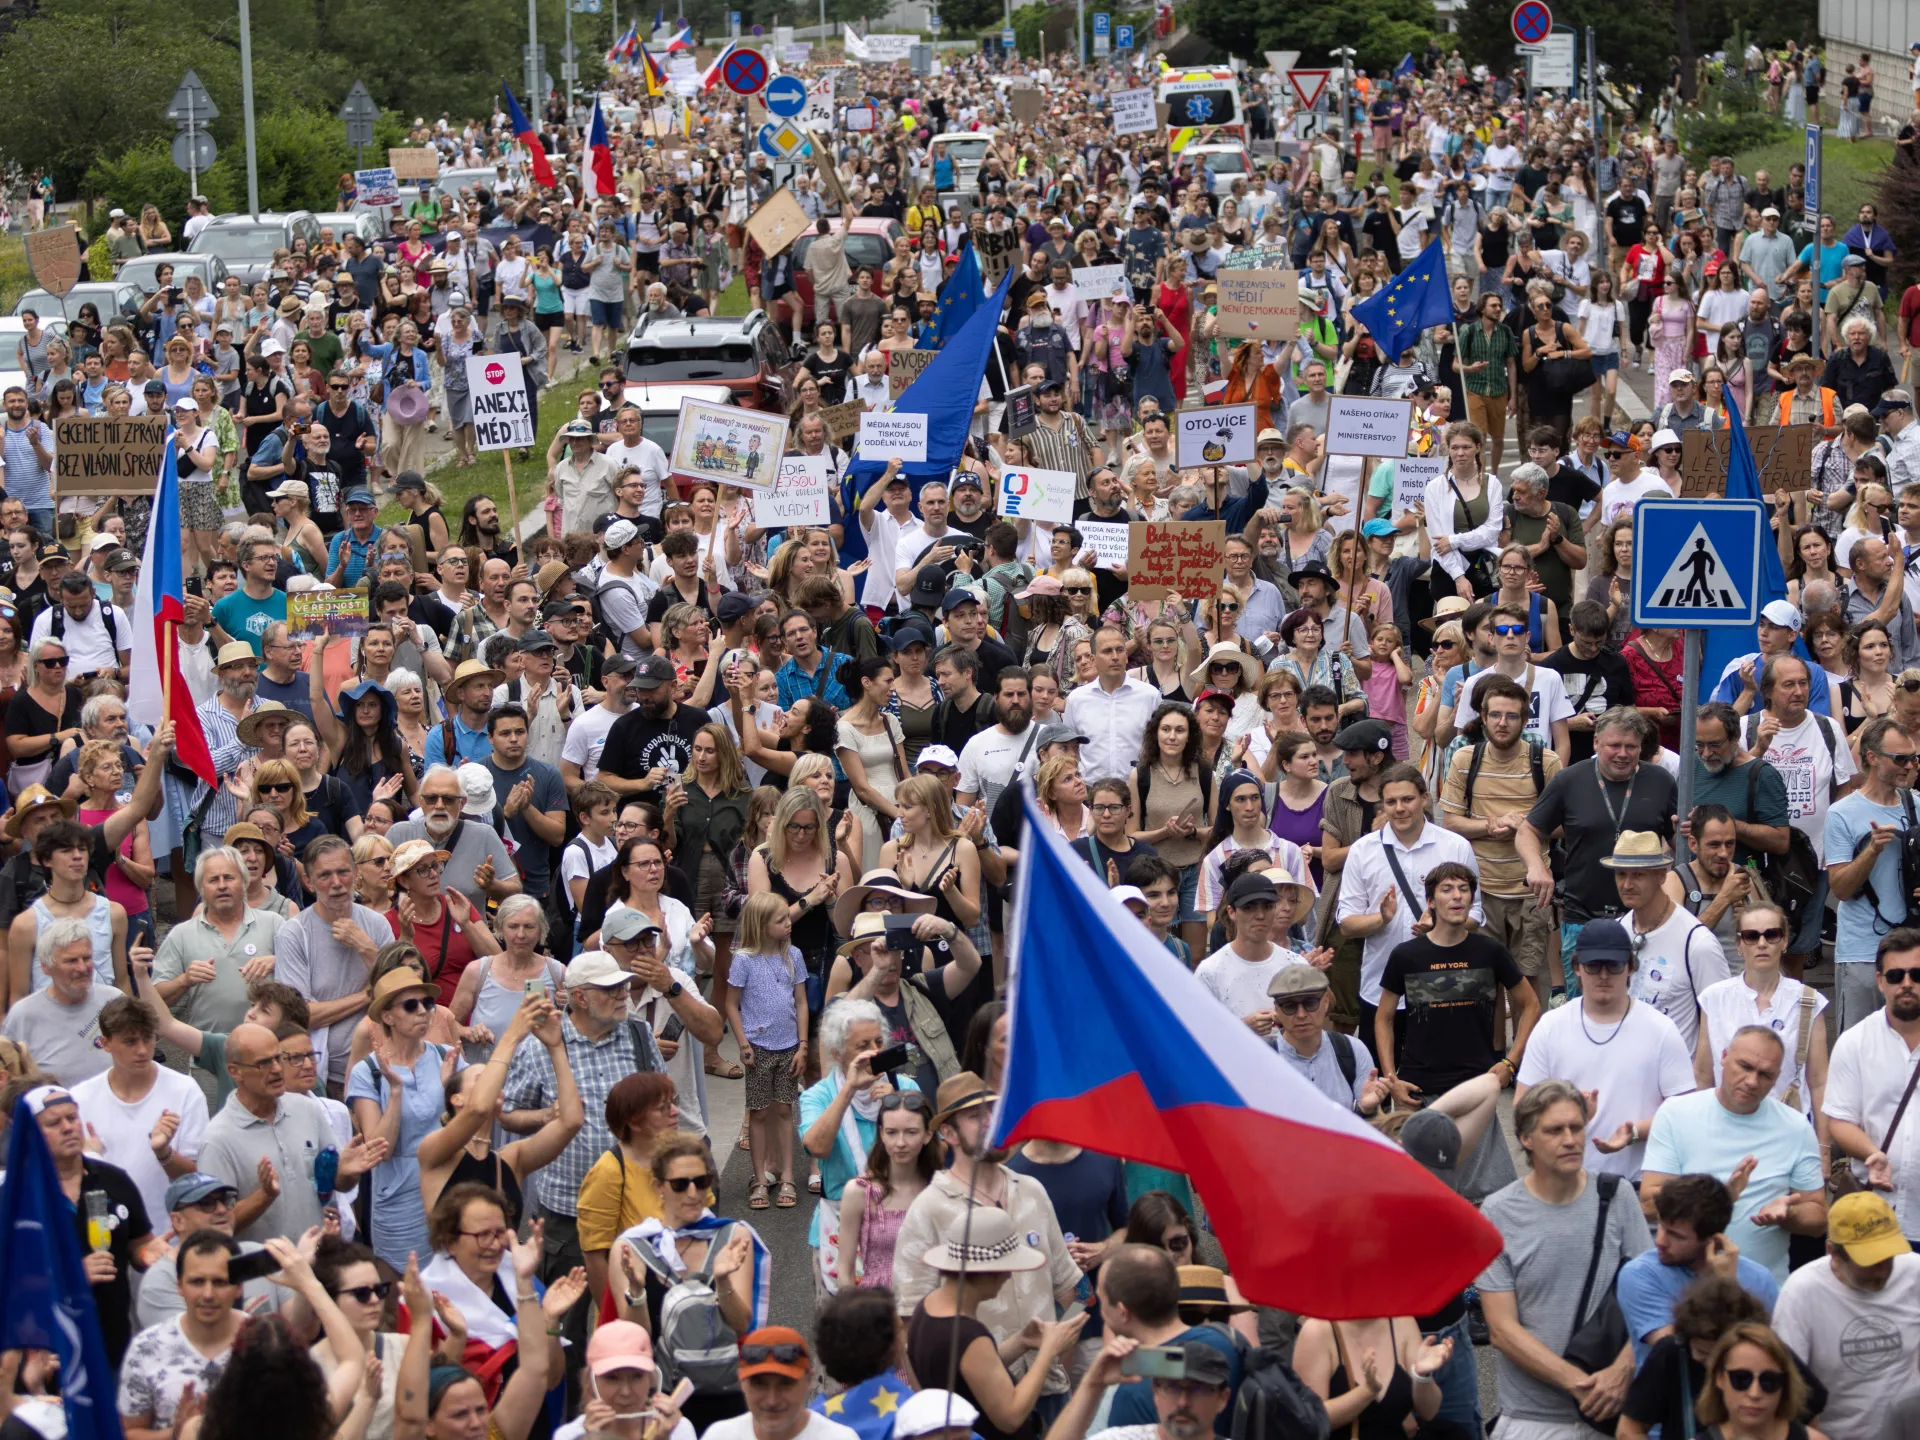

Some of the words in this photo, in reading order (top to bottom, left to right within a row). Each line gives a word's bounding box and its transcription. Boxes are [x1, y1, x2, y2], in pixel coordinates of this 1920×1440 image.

[1173, 82, 1224, 90] AMBULANCE
[1221, 279, 1234, 288] BEZ
[1236, 279, 1286, 290] NEZÁVISLÝCH
[1228, 289, 1265, 303] MÉDIÍ
[1222, 302, 1242, 314] NENÍ
[1243, 305, 1298, 316] DEMOKRACIE
[486, 369, 504, 379] STOP
[474, 390, 528, 415] ANEXI
[1339, 408, 1372, 418] NAŠEHO
[1372, 410, 1399, 420] OTÍKA?
[866, 420, 891, 429] MÉDIA
[892, 422, 922, 430] NEJSOU
[1185, 413, 1247, 431] OTO-VÍCE
[1362, 422, 1374, 430] NA
[57, 422, 101, 445] CHCEME
[103, 417, 121, 444] MÍT
[123, 417, 167, 444] ZPRÁVY
[476, 413, 533, 446] MÉDIÍ
[878, 430, 910, 438] TISKOVÉ
[1337, 431, 1397, 442] MINISTERSTVO?
[864, 439, 897, 447] ODDĚLNÍ
[58, 454, 80, 477] BEZ
[82, 445, 126, 477] VLÁDNÍ
[1400, 464, 1439, 474] Nechceme
[777, 475, 817, 488] EJSOU
[1402, 479, 1424, 489] místo
[1399, 493, 1425, 504] Agrofe
[773, 500, 810, 517] VLÁDY
[1081, 525, 1104, 533] MÉDIA
[1105, 527, 1128, 535] NEPAT
[2, 561, 14, 572] 21
[1147, 558, 1174, 573] když
[294, 592, 312, 603] ČT
[294, 601, 366, 613] VEŘEJNOSTI
[1448, 961, 1469, 969] YORK
